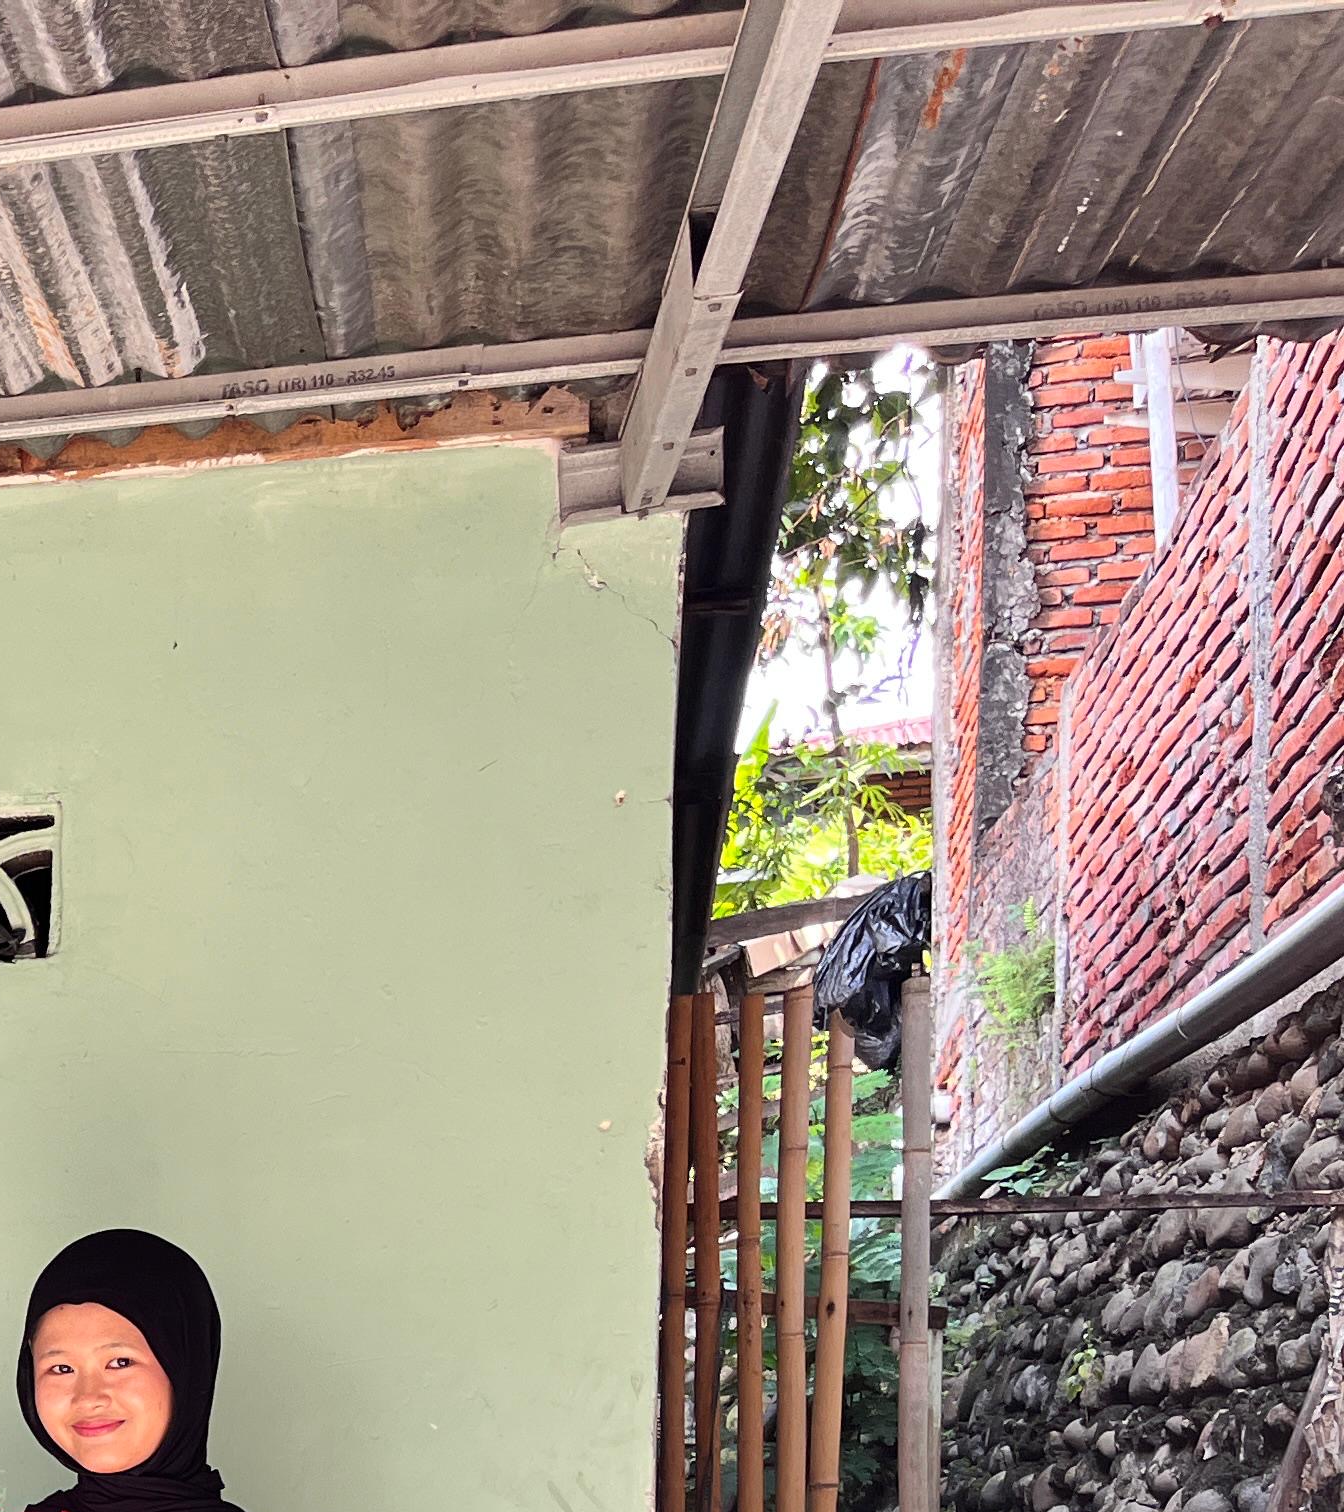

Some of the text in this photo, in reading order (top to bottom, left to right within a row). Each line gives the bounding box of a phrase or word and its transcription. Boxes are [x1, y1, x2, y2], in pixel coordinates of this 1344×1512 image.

[222, 379, 270, 399] TASO
[278, 377, 307, 393] (TR)
[311, 373, 334, 388] 110
